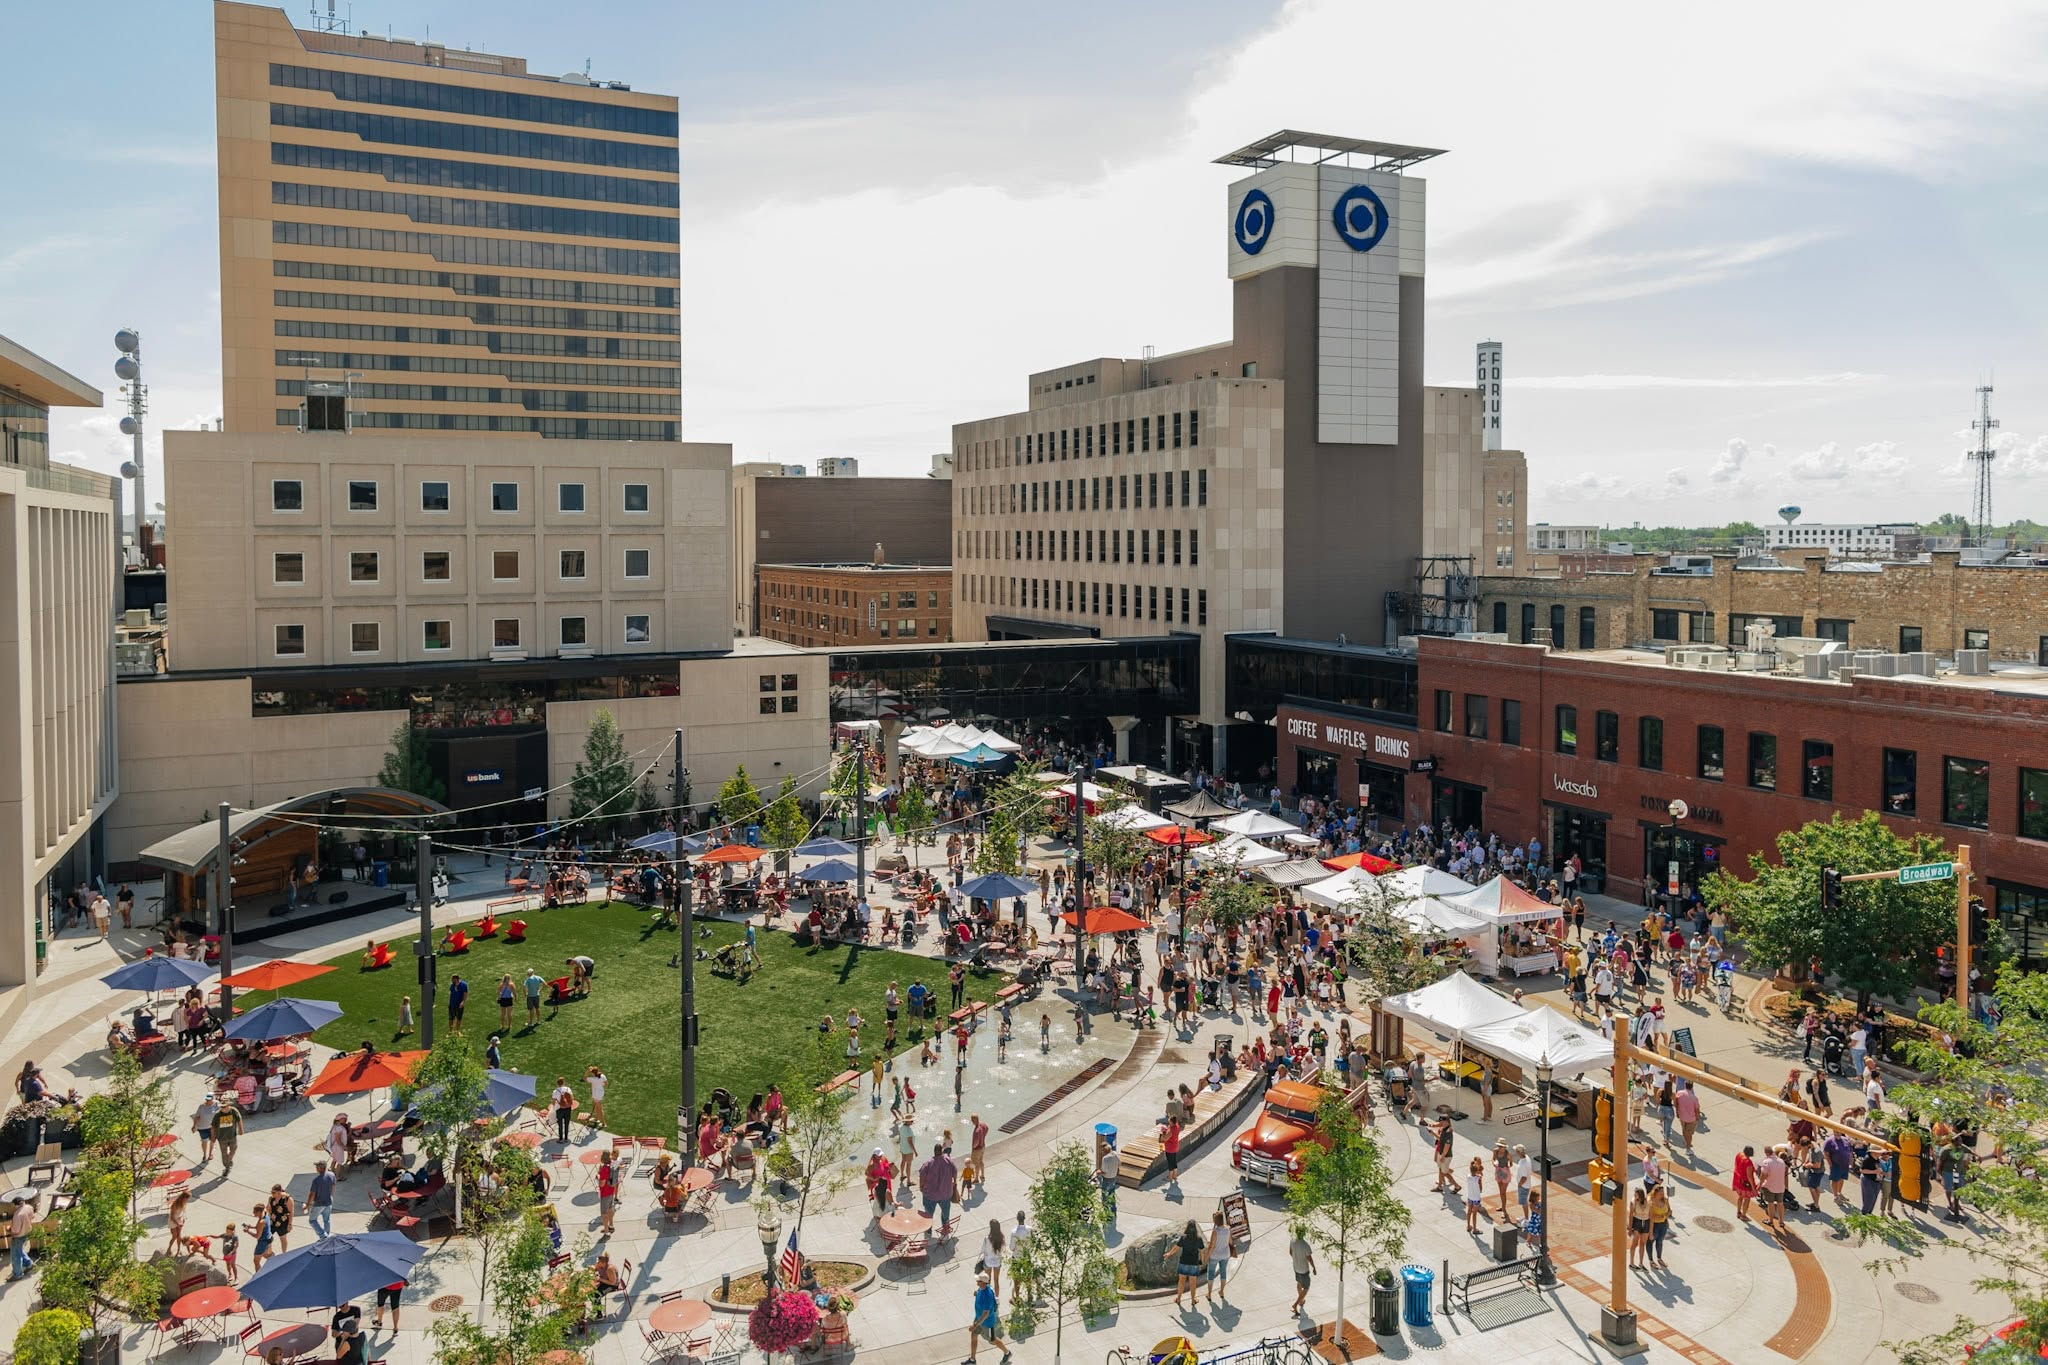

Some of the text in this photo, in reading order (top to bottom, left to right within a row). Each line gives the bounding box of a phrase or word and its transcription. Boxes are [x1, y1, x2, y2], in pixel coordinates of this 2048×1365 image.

[1491, 352, 1500, 429] FORUM
[1287, 718, 1409, 758] COFFEE WAFFLES DRINKS
[1903, 866, 1949, 880] Broadway
[1507, 1112, 1536, 1123] BROADWAY
